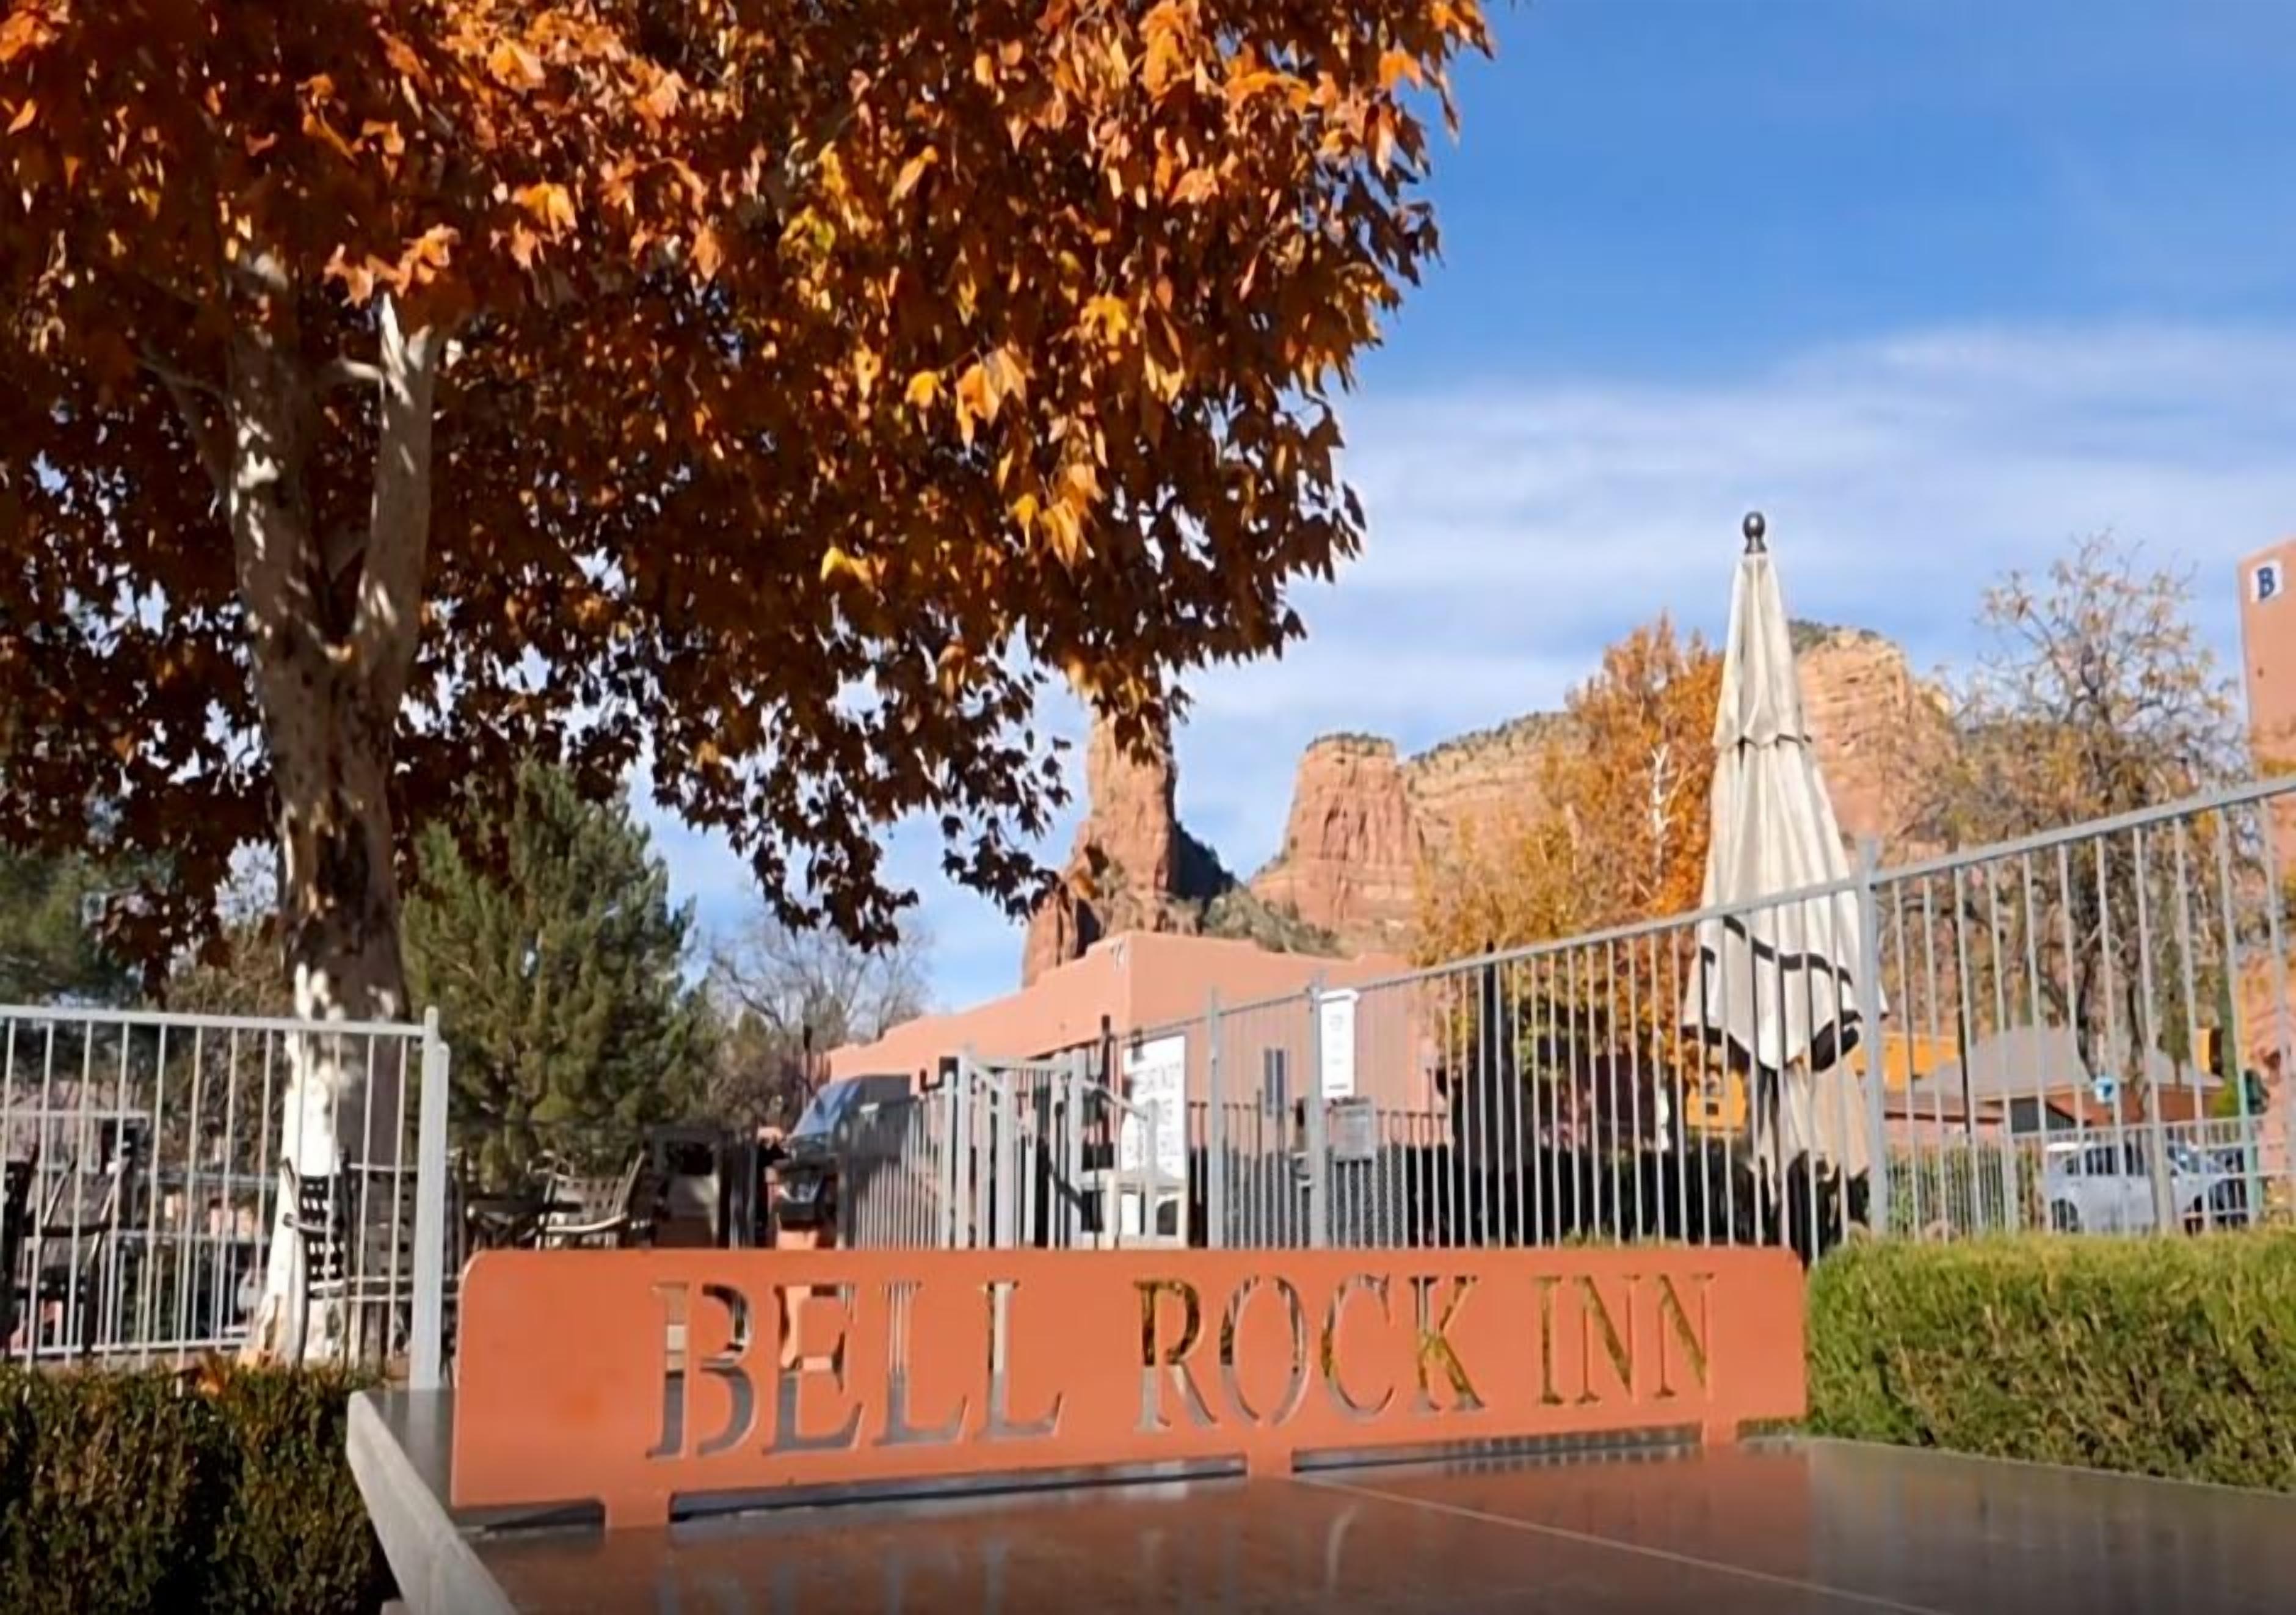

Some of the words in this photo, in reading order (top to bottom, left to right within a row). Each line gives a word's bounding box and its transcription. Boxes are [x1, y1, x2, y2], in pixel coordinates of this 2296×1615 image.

[2258, 567, 2275, 599] B
[645, 1280, 1064, 1459] BELL
[1133, 1274, 1486, 1434] ROCK
[1531, 1272, 1716, 1407] INN
